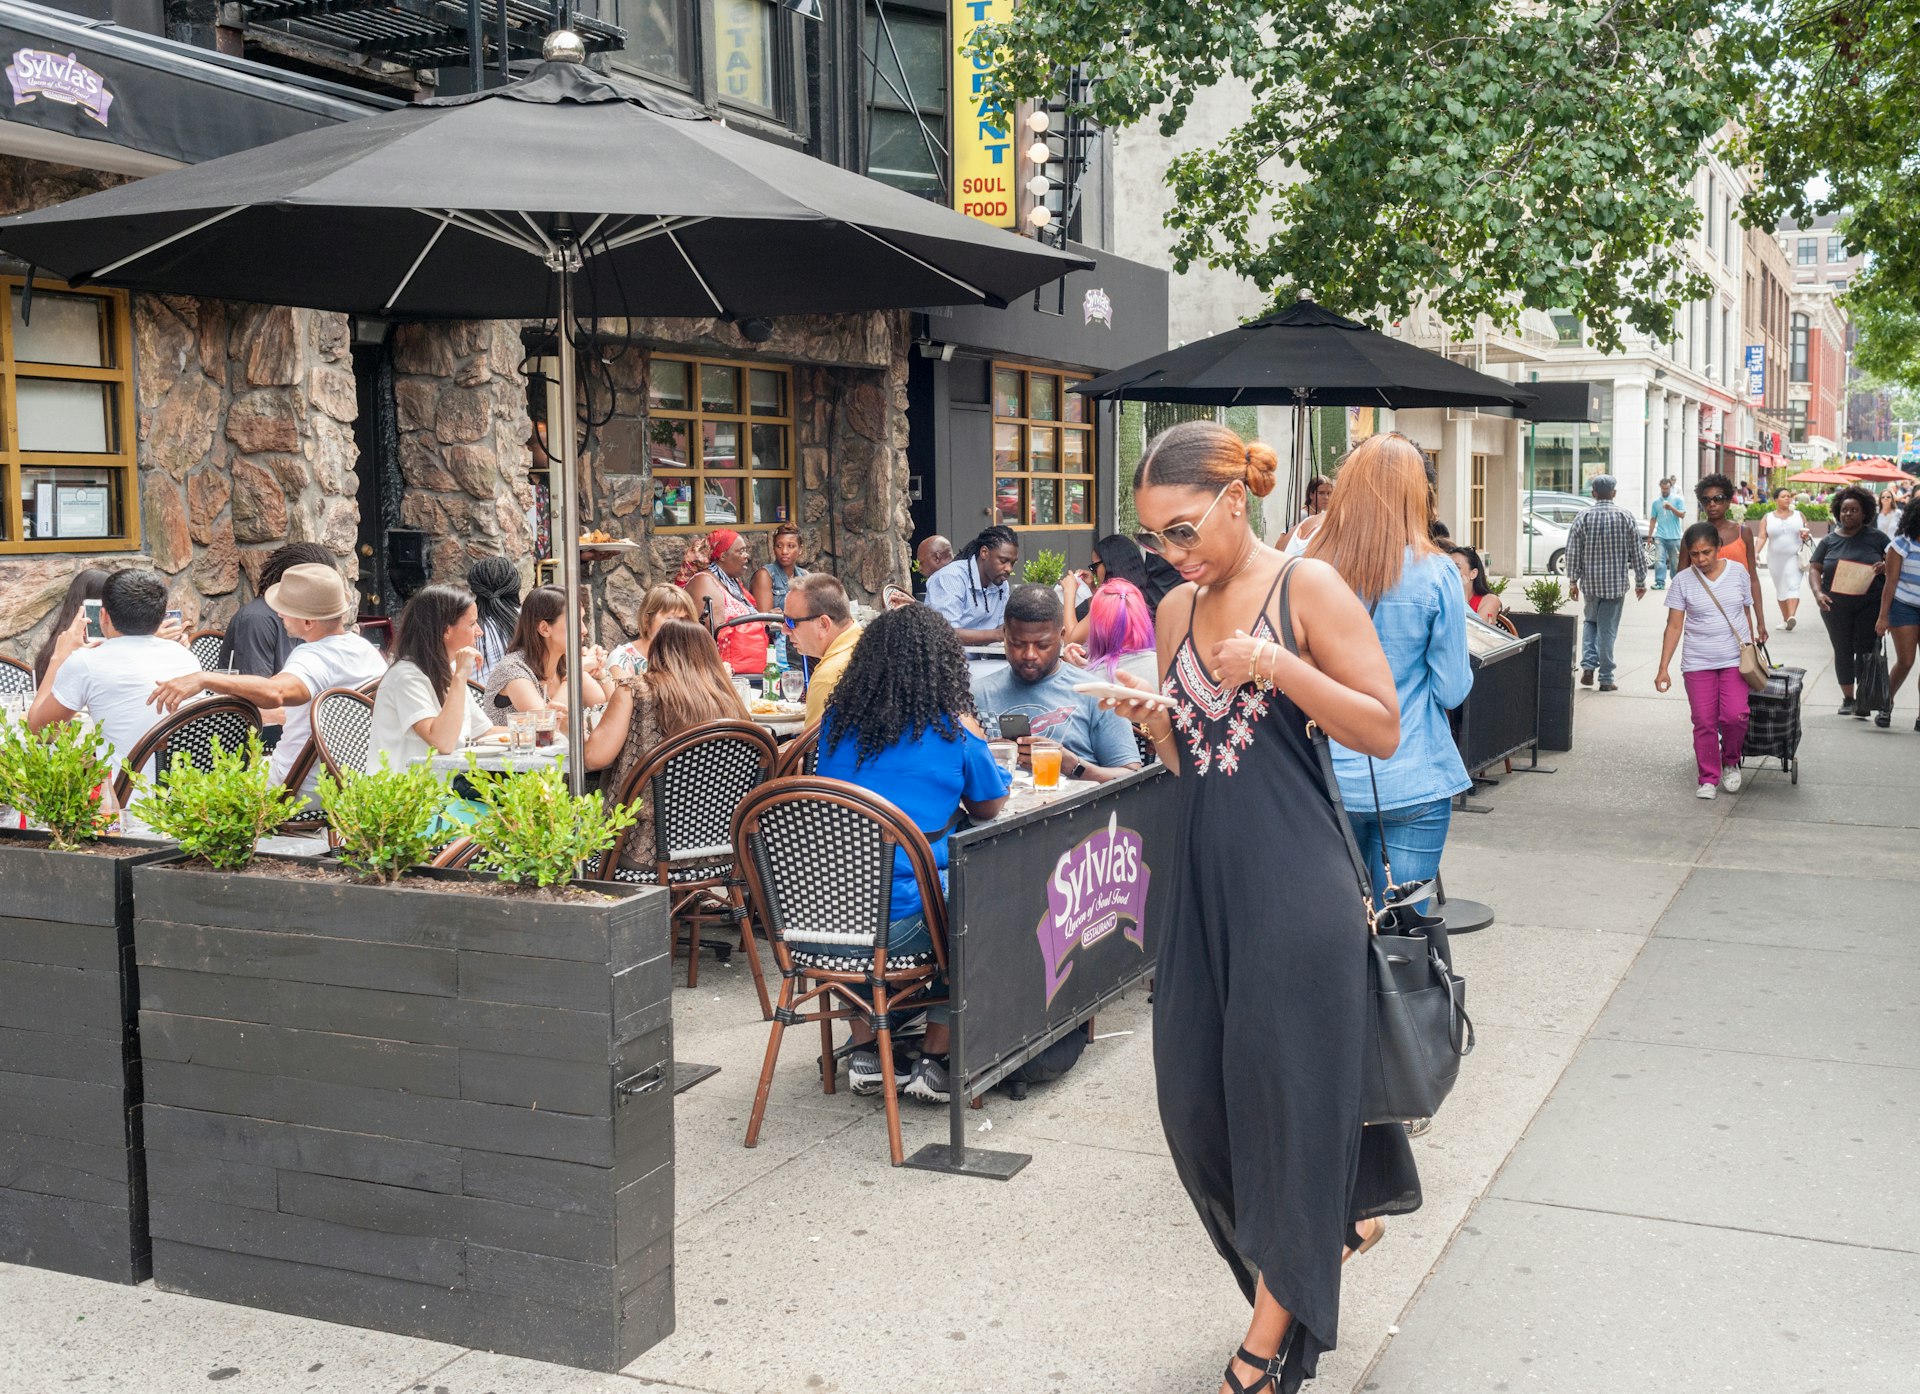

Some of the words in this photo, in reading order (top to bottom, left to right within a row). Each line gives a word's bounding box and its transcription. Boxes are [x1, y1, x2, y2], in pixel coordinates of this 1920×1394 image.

[19, 48, 97, 93] Sylvia's
[962, 177, 1006, 194] SOUL
[963, 201, 1008, 217] FOOD
[1751, 347, 1763, 371] SALE
[1751, 375, 1763, 394] FOR
[1054, 811, 1137, 928] Sylvia's
[1065, 911, 1086, 940] Queen
[1086, 898, 1096, 922] of
[1095, 890, 1112, 911] Soul
[1111, 888, 1130, 905] Food
